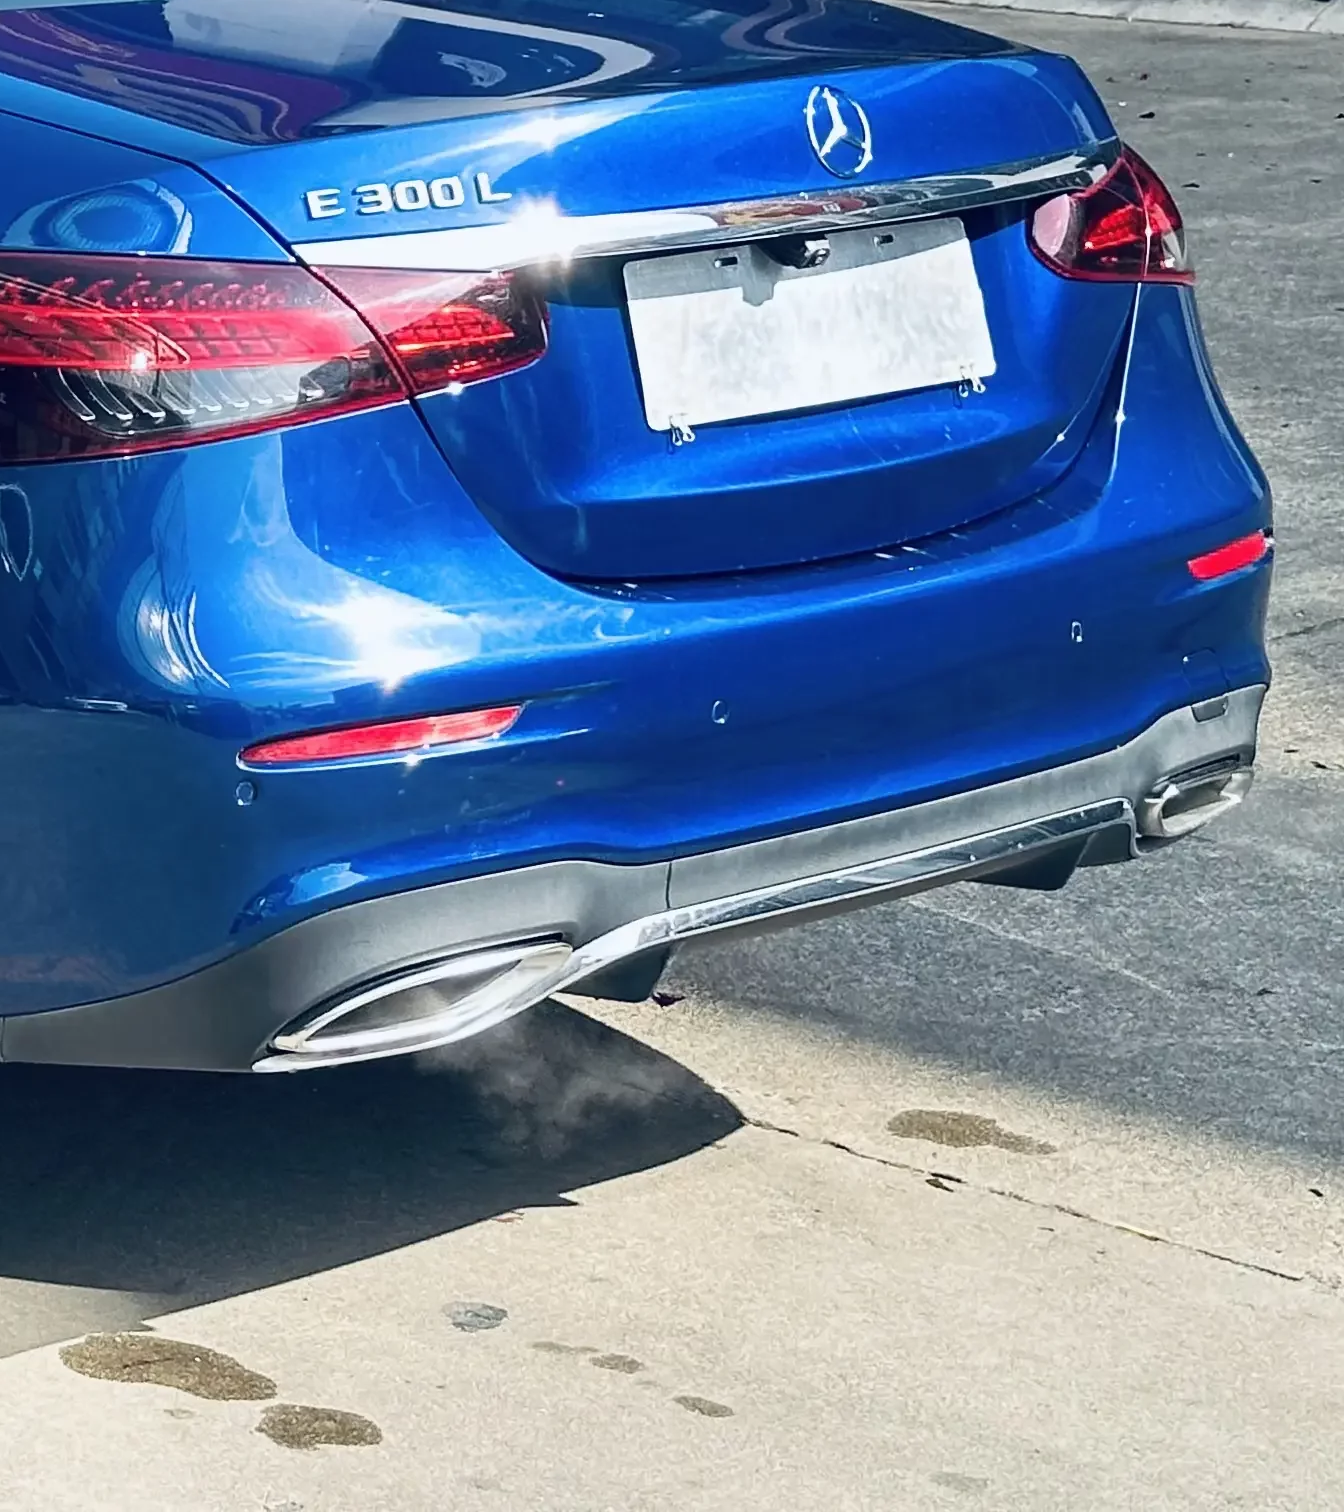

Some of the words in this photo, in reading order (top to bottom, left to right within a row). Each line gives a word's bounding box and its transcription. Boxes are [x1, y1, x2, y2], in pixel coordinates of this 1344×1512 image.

[305, 188, 346, 219] E
[352, 175, 465, 216] 300
[475, 172, 513, 204] L
